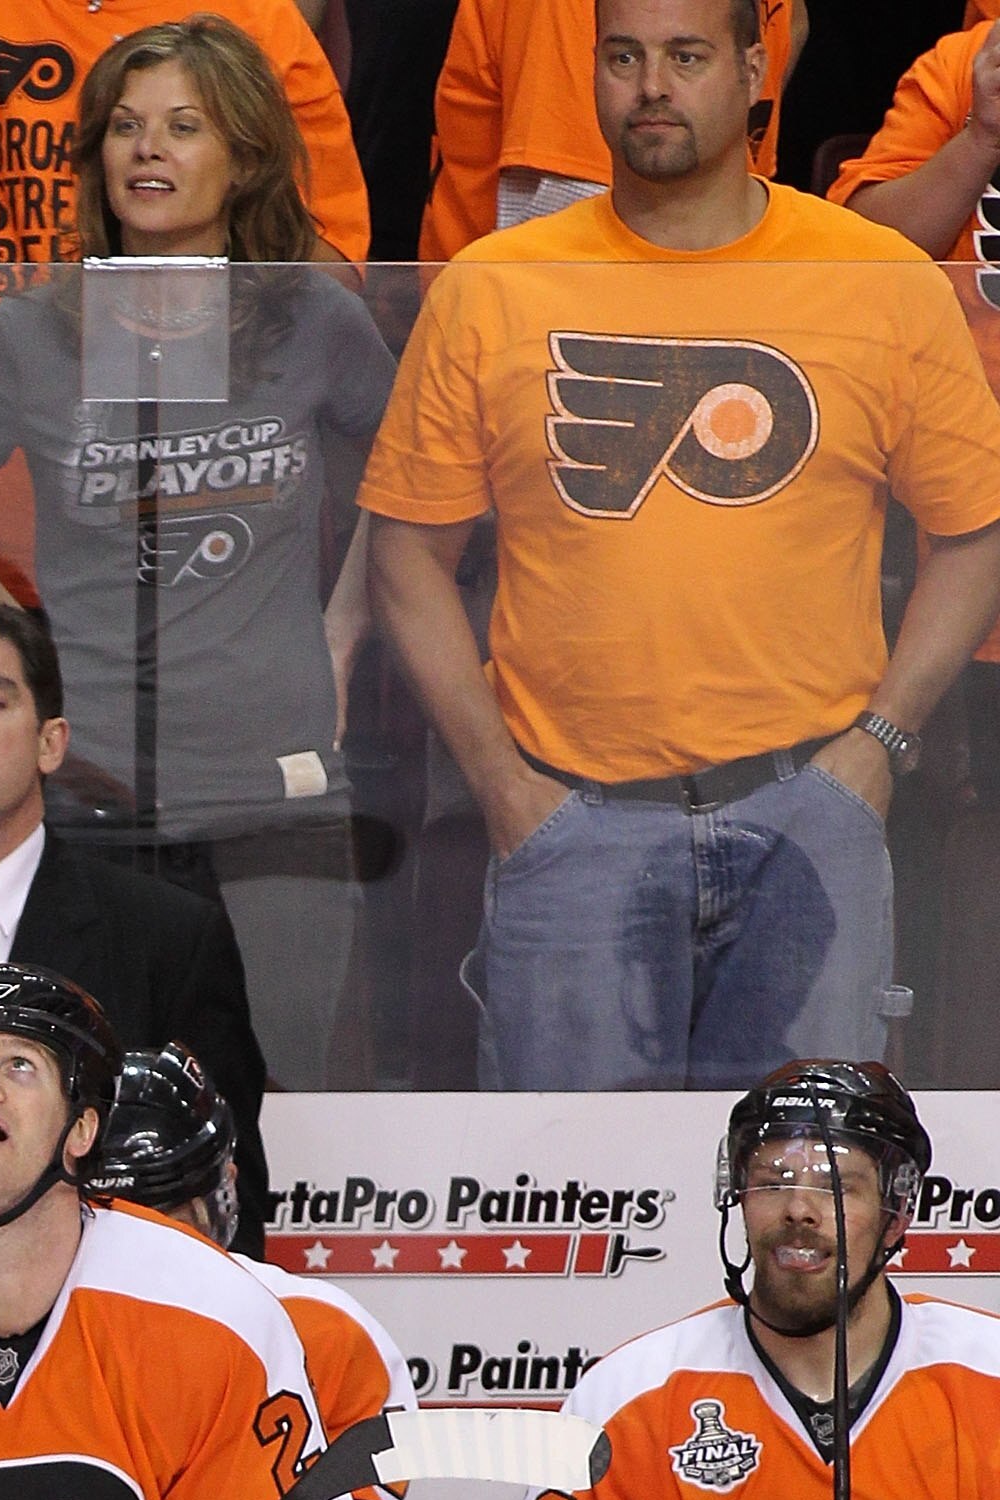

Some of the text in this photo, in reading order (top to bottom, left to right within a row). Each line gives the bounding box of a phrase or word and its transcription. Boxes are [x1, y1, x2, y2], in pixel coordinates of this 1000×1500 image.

[81, 422, 281, 467] STANLEY CUP
[80, 439, 307, 504] PLAYOFFS
[446, 1173, 662, 1223] Painters
[681, 1441, 754, 1465] FINAL
